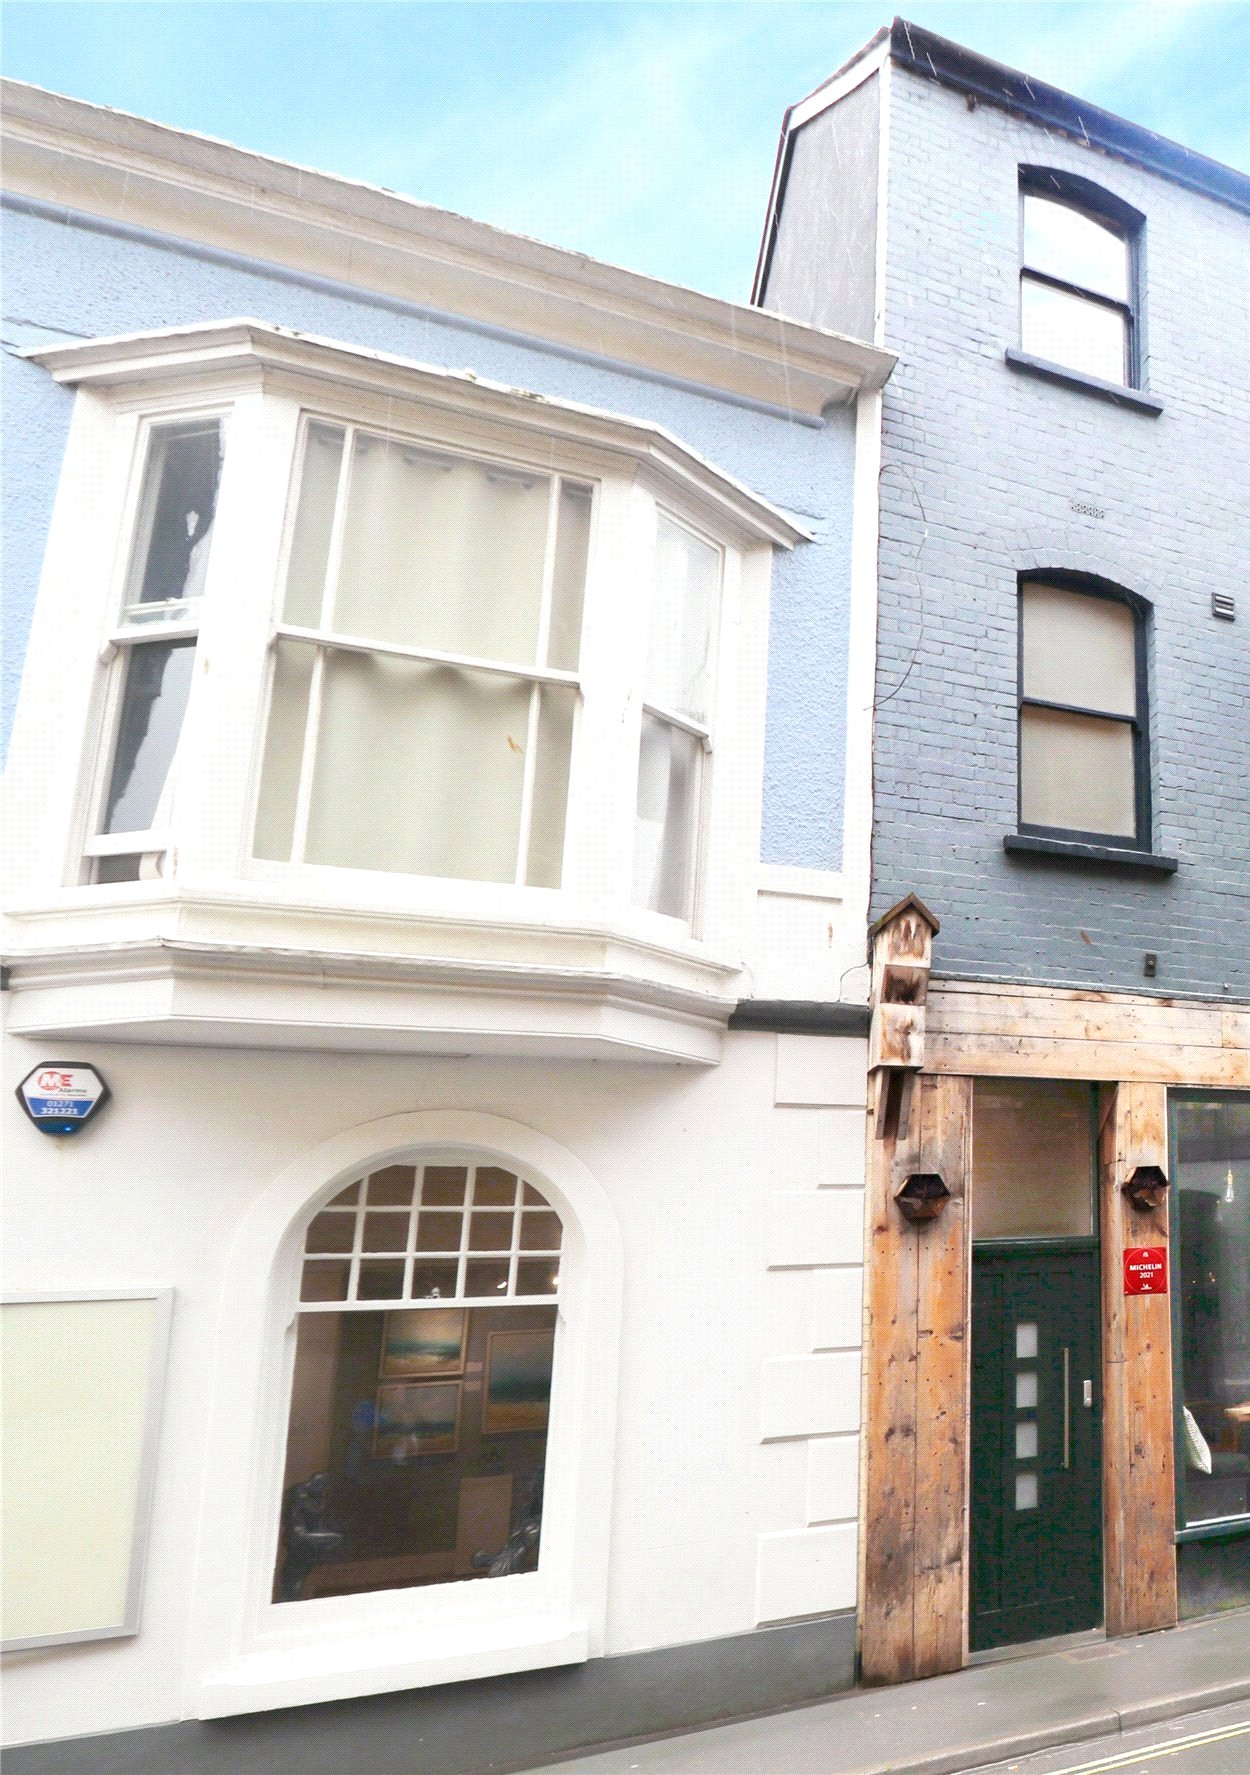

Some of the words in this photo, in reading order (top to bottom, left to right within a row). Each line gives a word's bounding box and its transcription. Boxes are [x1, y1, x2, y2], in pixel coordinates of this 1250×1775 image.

[41, 1107, 78, 1115] 321221
[1129, 1263, 1162, 1271] MICHELIN
[1139, 1271, 1154, 1279] 2021
